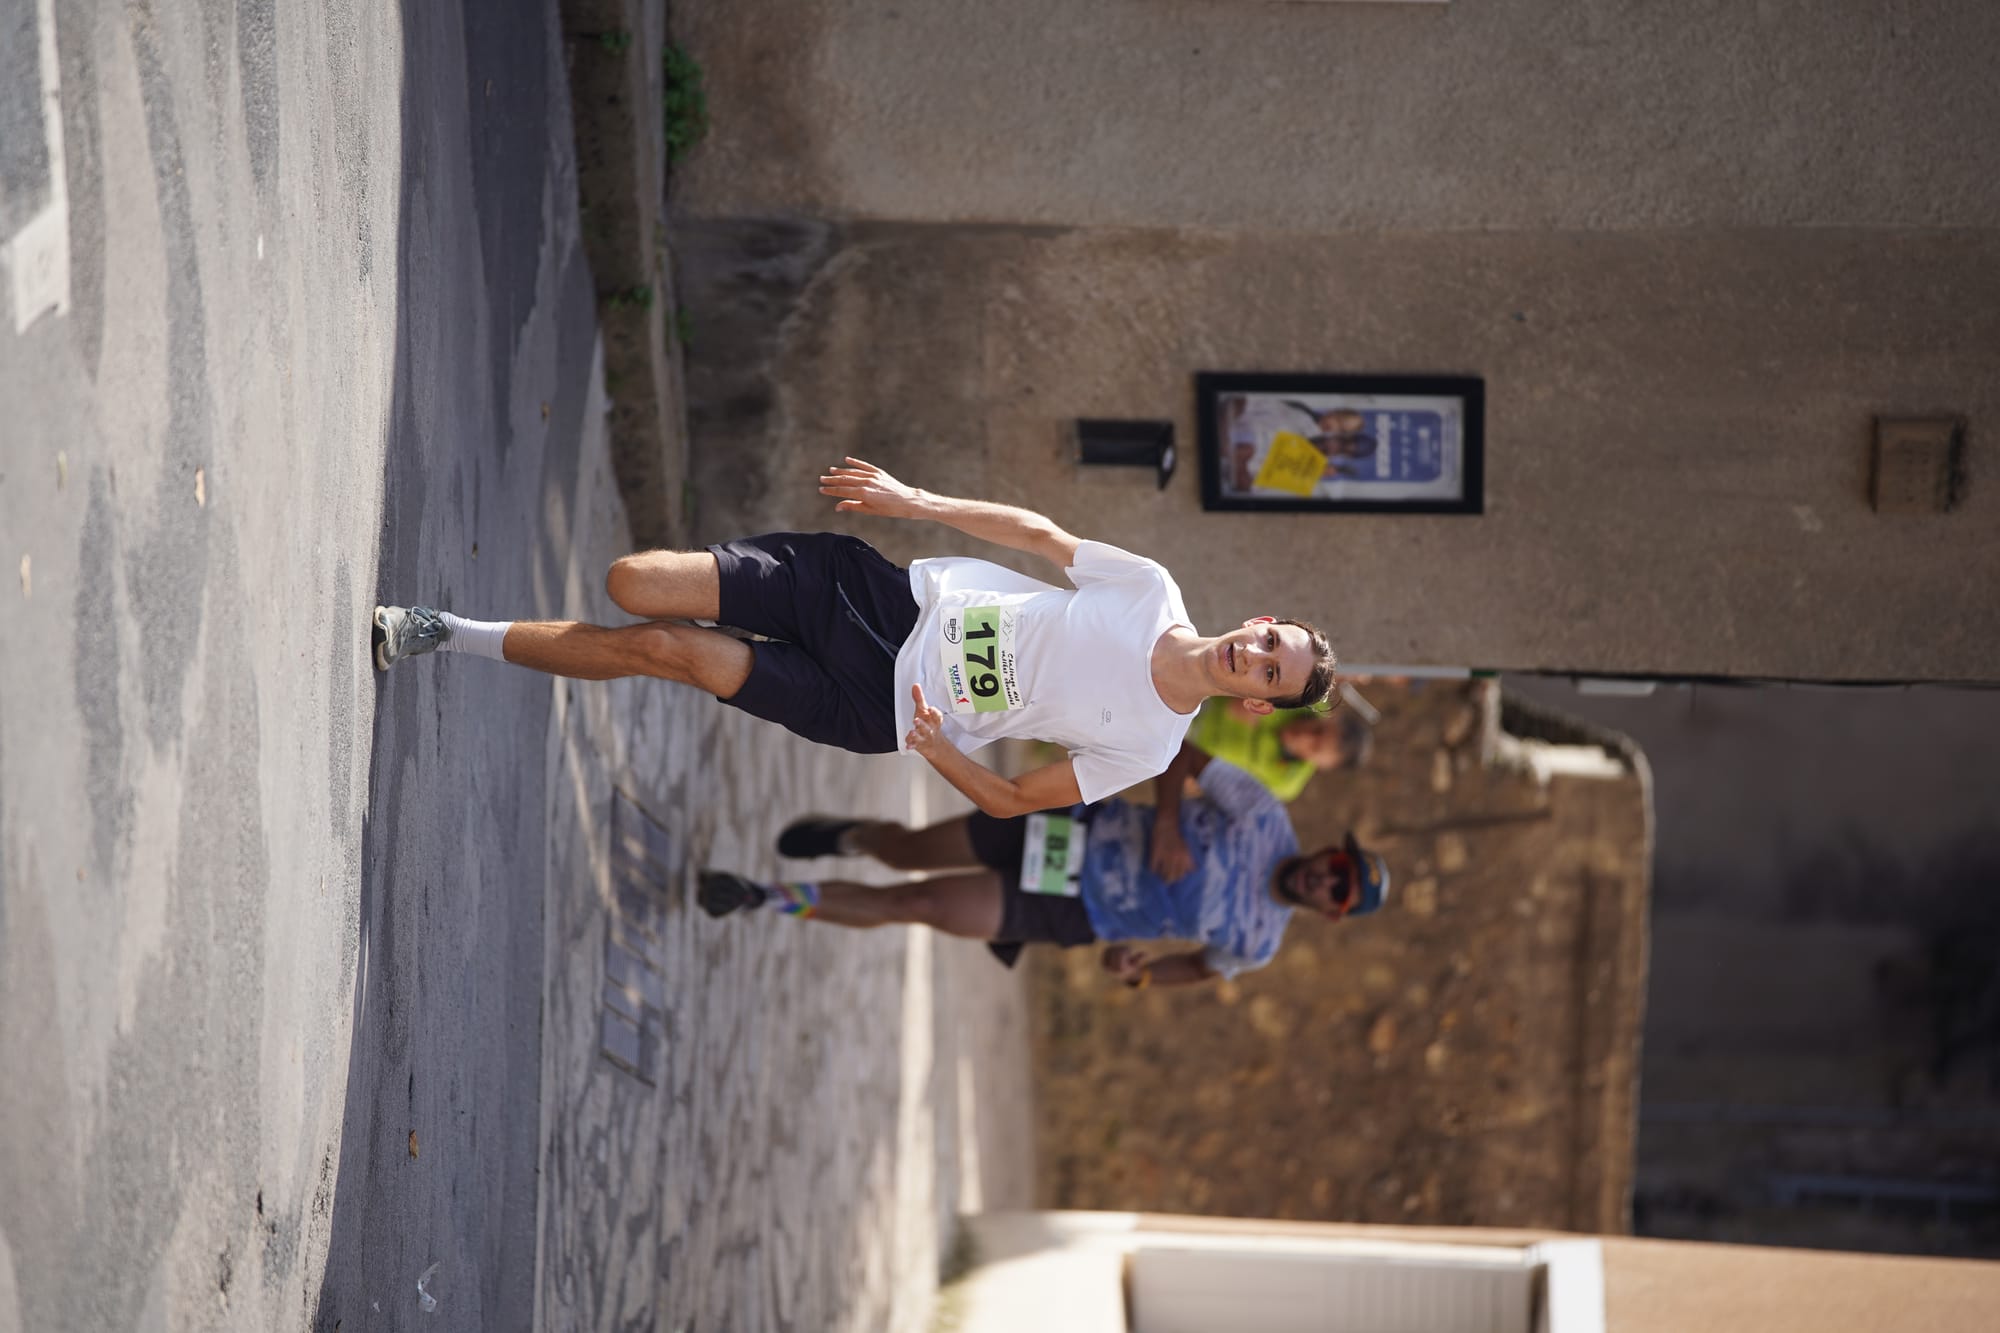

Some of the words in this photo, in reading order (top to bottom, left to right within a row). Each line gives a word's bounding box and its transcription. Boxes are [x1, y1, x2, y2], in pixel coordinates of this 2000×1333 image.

[966, 622, 999, 697] 179
[1007, 653, 1016, 687] Challenge
[952, 664, 964, 695] TUFF'S
